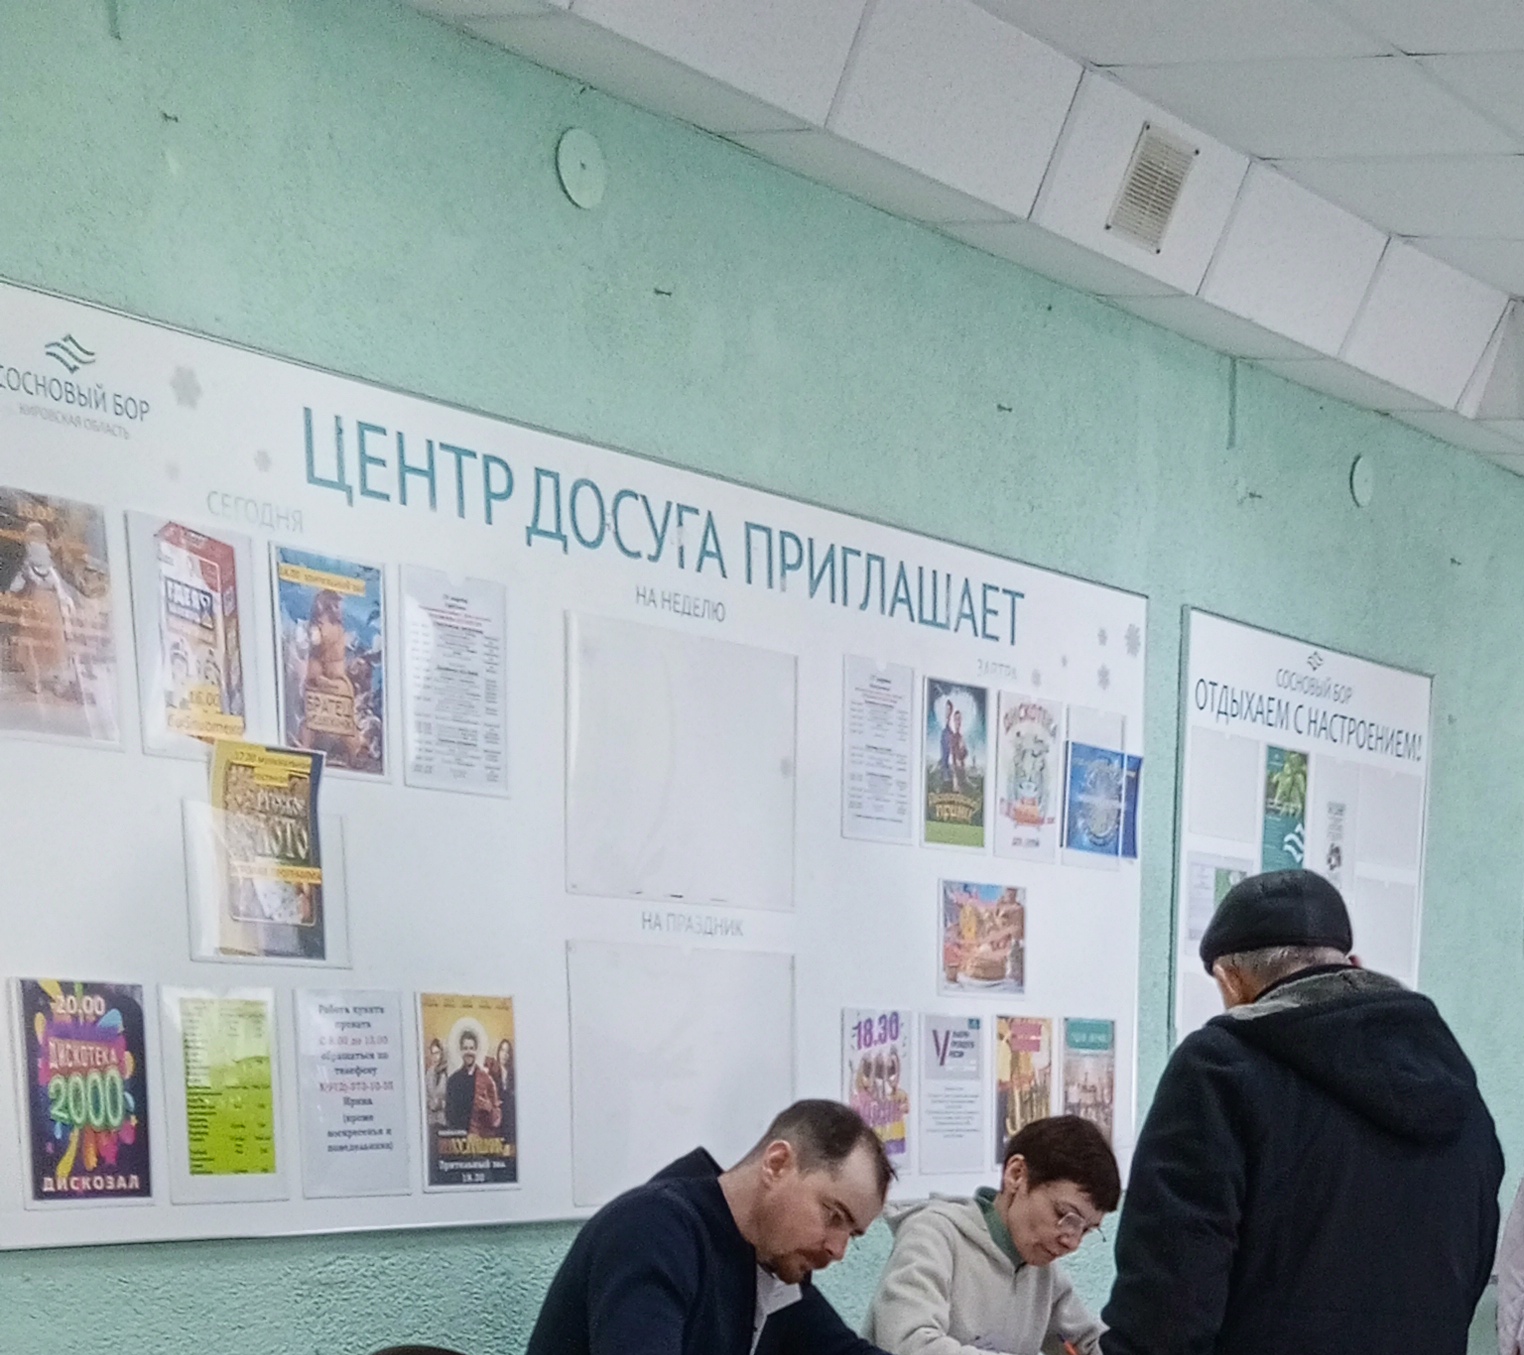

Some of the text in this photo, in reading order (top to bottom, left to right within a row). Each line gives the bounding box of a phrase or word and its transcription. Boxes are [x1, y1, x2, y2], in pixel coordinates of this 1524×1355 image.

[19, 402, 130, 439] КИРОВСКАЯ ОБЛАСТЬ
[113, 394, 151, 422] БОР
[206, 490, 304, 534] СЕГОДНЯ
[303, 406, 1025, 646] ЦЕНТР ДОСУГА ПРИГЛАШАЕТ
[636, 585, 727, 623] НА НЕДЕЛЮ
[1276, 668, 1353, 705] СОСНОВЫЙ БОР
[1195, 678, 1423, 762] ОТДЫХАЕМ С НАСТРОЕНИЕМ!
[642, 911, 743, 936] НА ПРАЗДНИК
[54, 995, 106, 1016] 20.00
[853, 1011, 900, 1050] 18.30
[49, 1041, 120, 1069] ДИСКОТЕКА
[48, 1069, 124, 1129] 2000
[42, 1174, 141, 1193] ДИСКОЗАЛ
